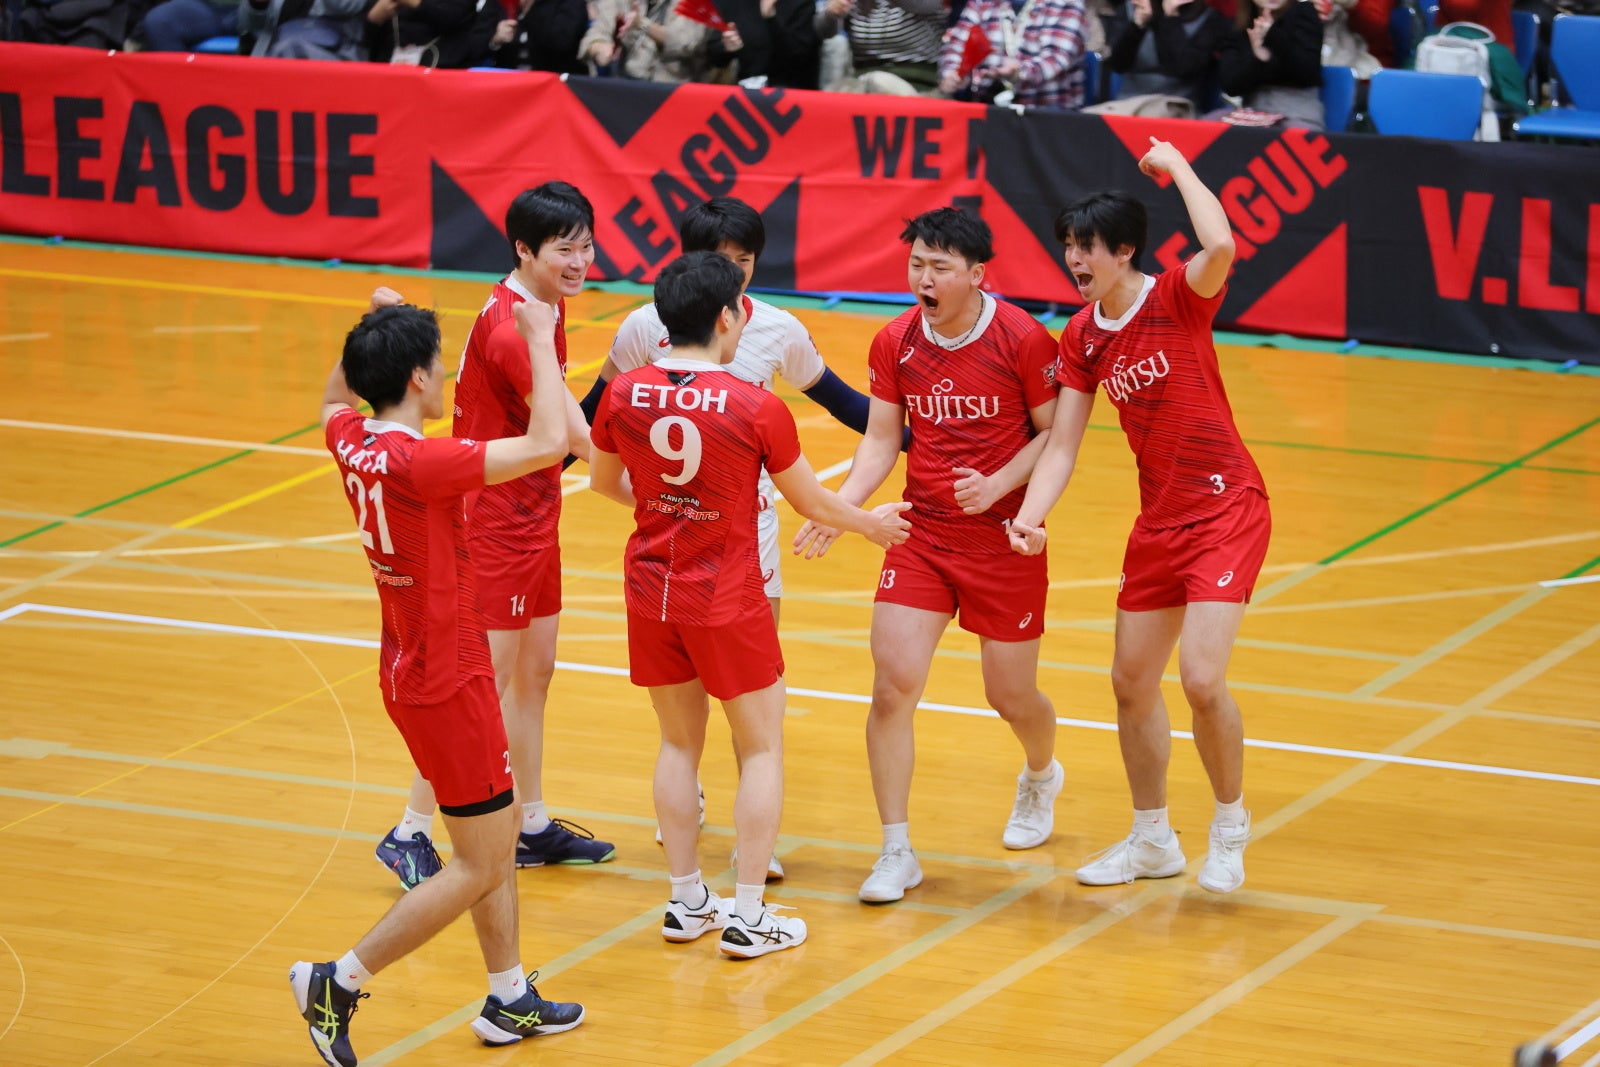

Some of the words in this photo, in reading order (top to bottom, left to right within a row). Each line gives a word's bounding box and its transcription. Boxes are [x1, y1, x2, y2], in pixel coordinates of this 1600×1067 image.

[0, 91, 379, 218] LEAGUE
[853, 115, 943, 180] WE
[1417, 185, 1600, 315] V.L
[631, 383, 728, 414] ETOH
[906, 394, 999, 425] FUJITSU
[336, 439, 388, 475] HATA
[649, 415, 702, 486] 9
[1209, 474, 1226, 495] 3
[346, 472, 395, 555] 21
[879, 569, 896, 590] 13
[510, 594, 526, 617] 14
